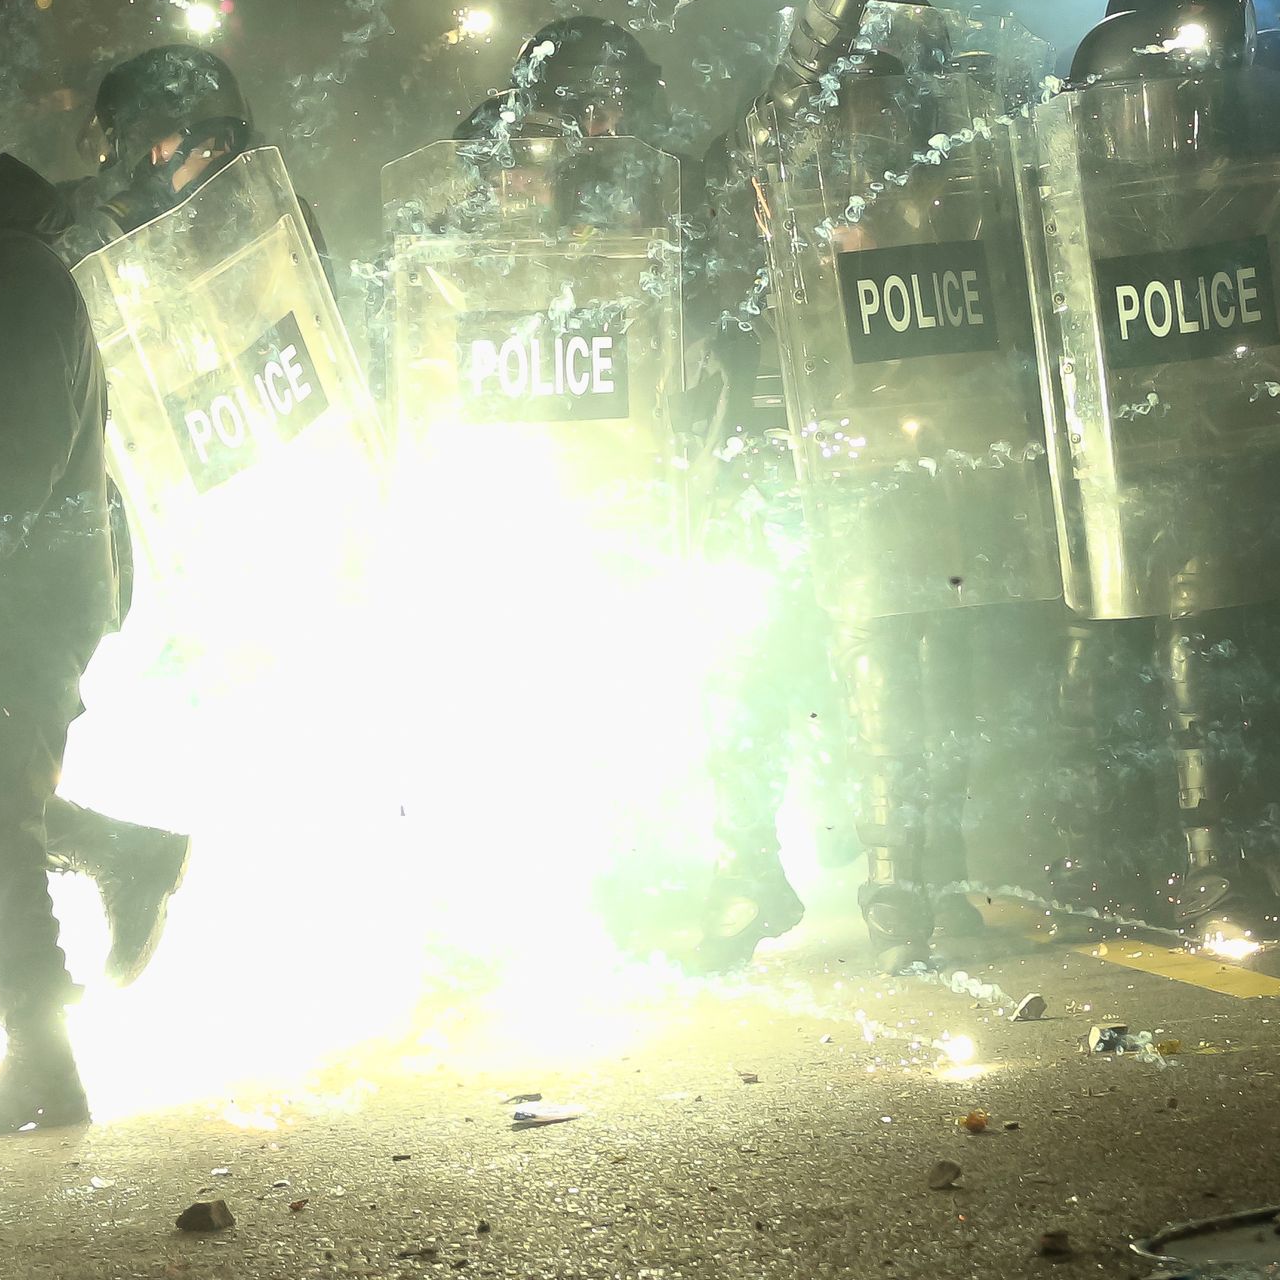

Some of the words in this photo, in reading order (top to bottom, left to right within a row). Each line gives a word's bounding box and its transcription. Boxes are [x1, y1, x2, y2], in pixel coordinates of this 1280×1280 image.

[857, 270, 984, 335] POLICE
[1115, 267, 1262, 341] POLICE
[470, 335, 615, 398] POLICE
